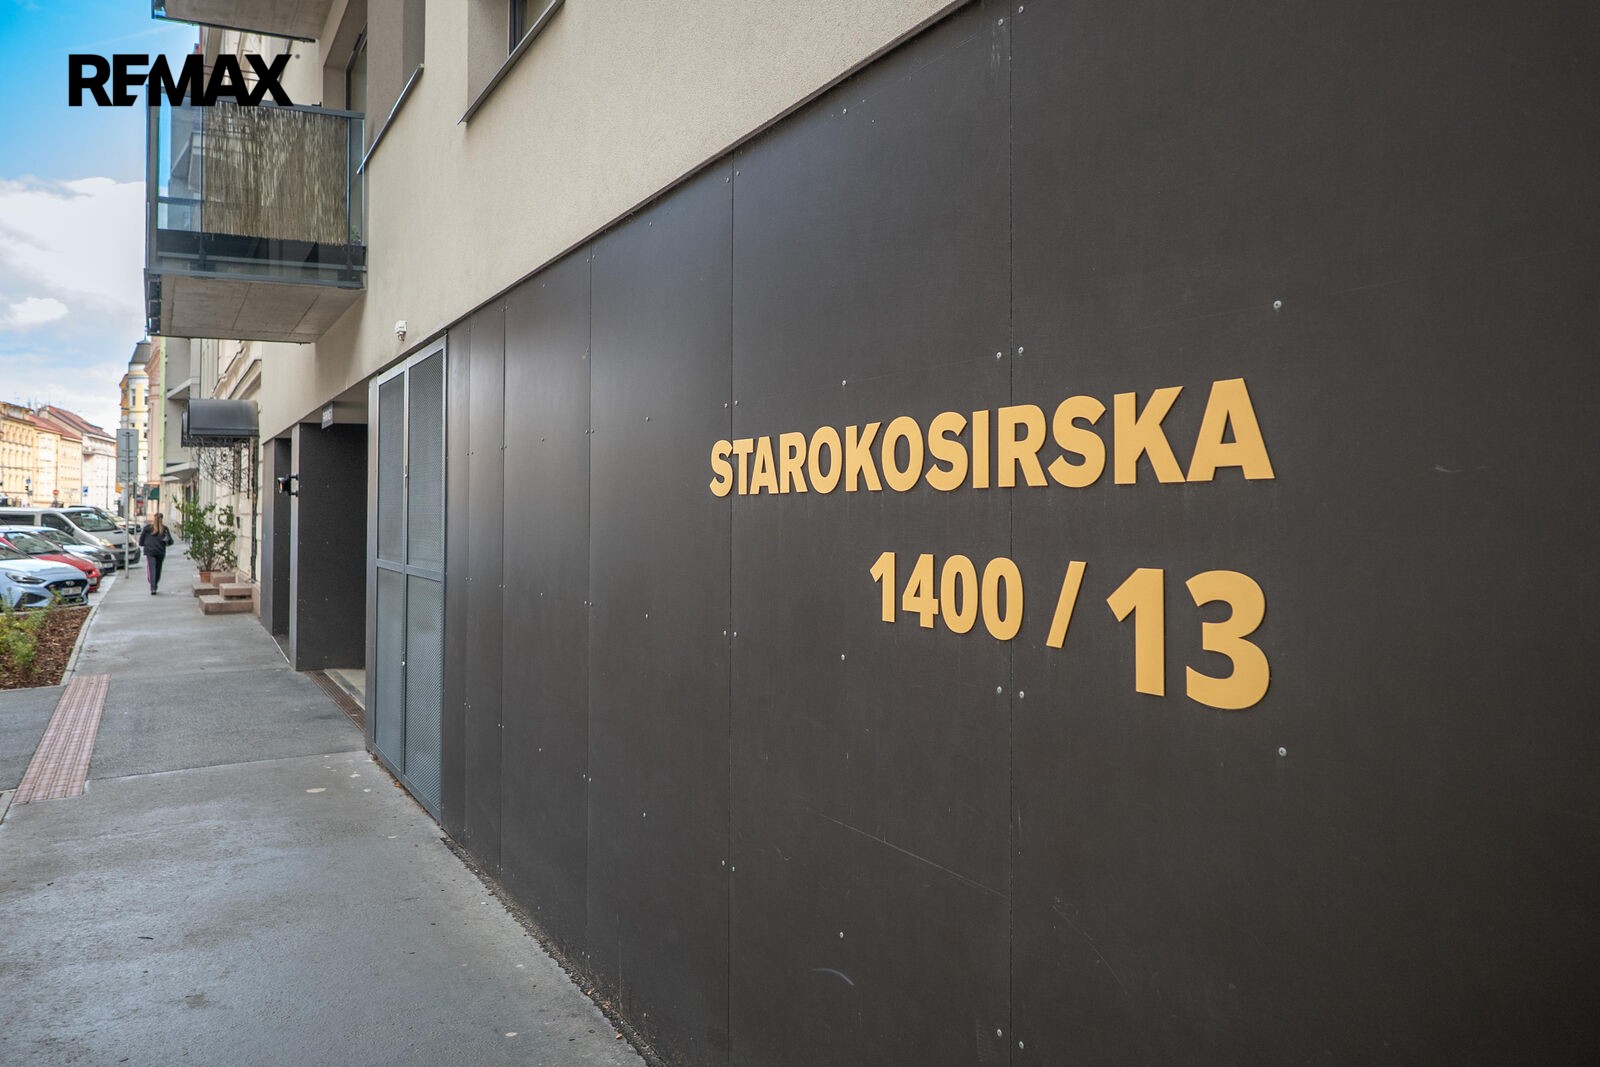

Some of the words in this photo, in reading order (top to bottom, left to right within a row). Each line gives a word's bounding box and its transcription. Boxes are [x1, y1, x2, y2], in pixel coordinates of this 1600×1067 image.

[709, 377, 1275, 498] STAROKOSIRSKA
[869, 551, 1024, 642] 1400
[1106, 567, 1271, 710] 13
